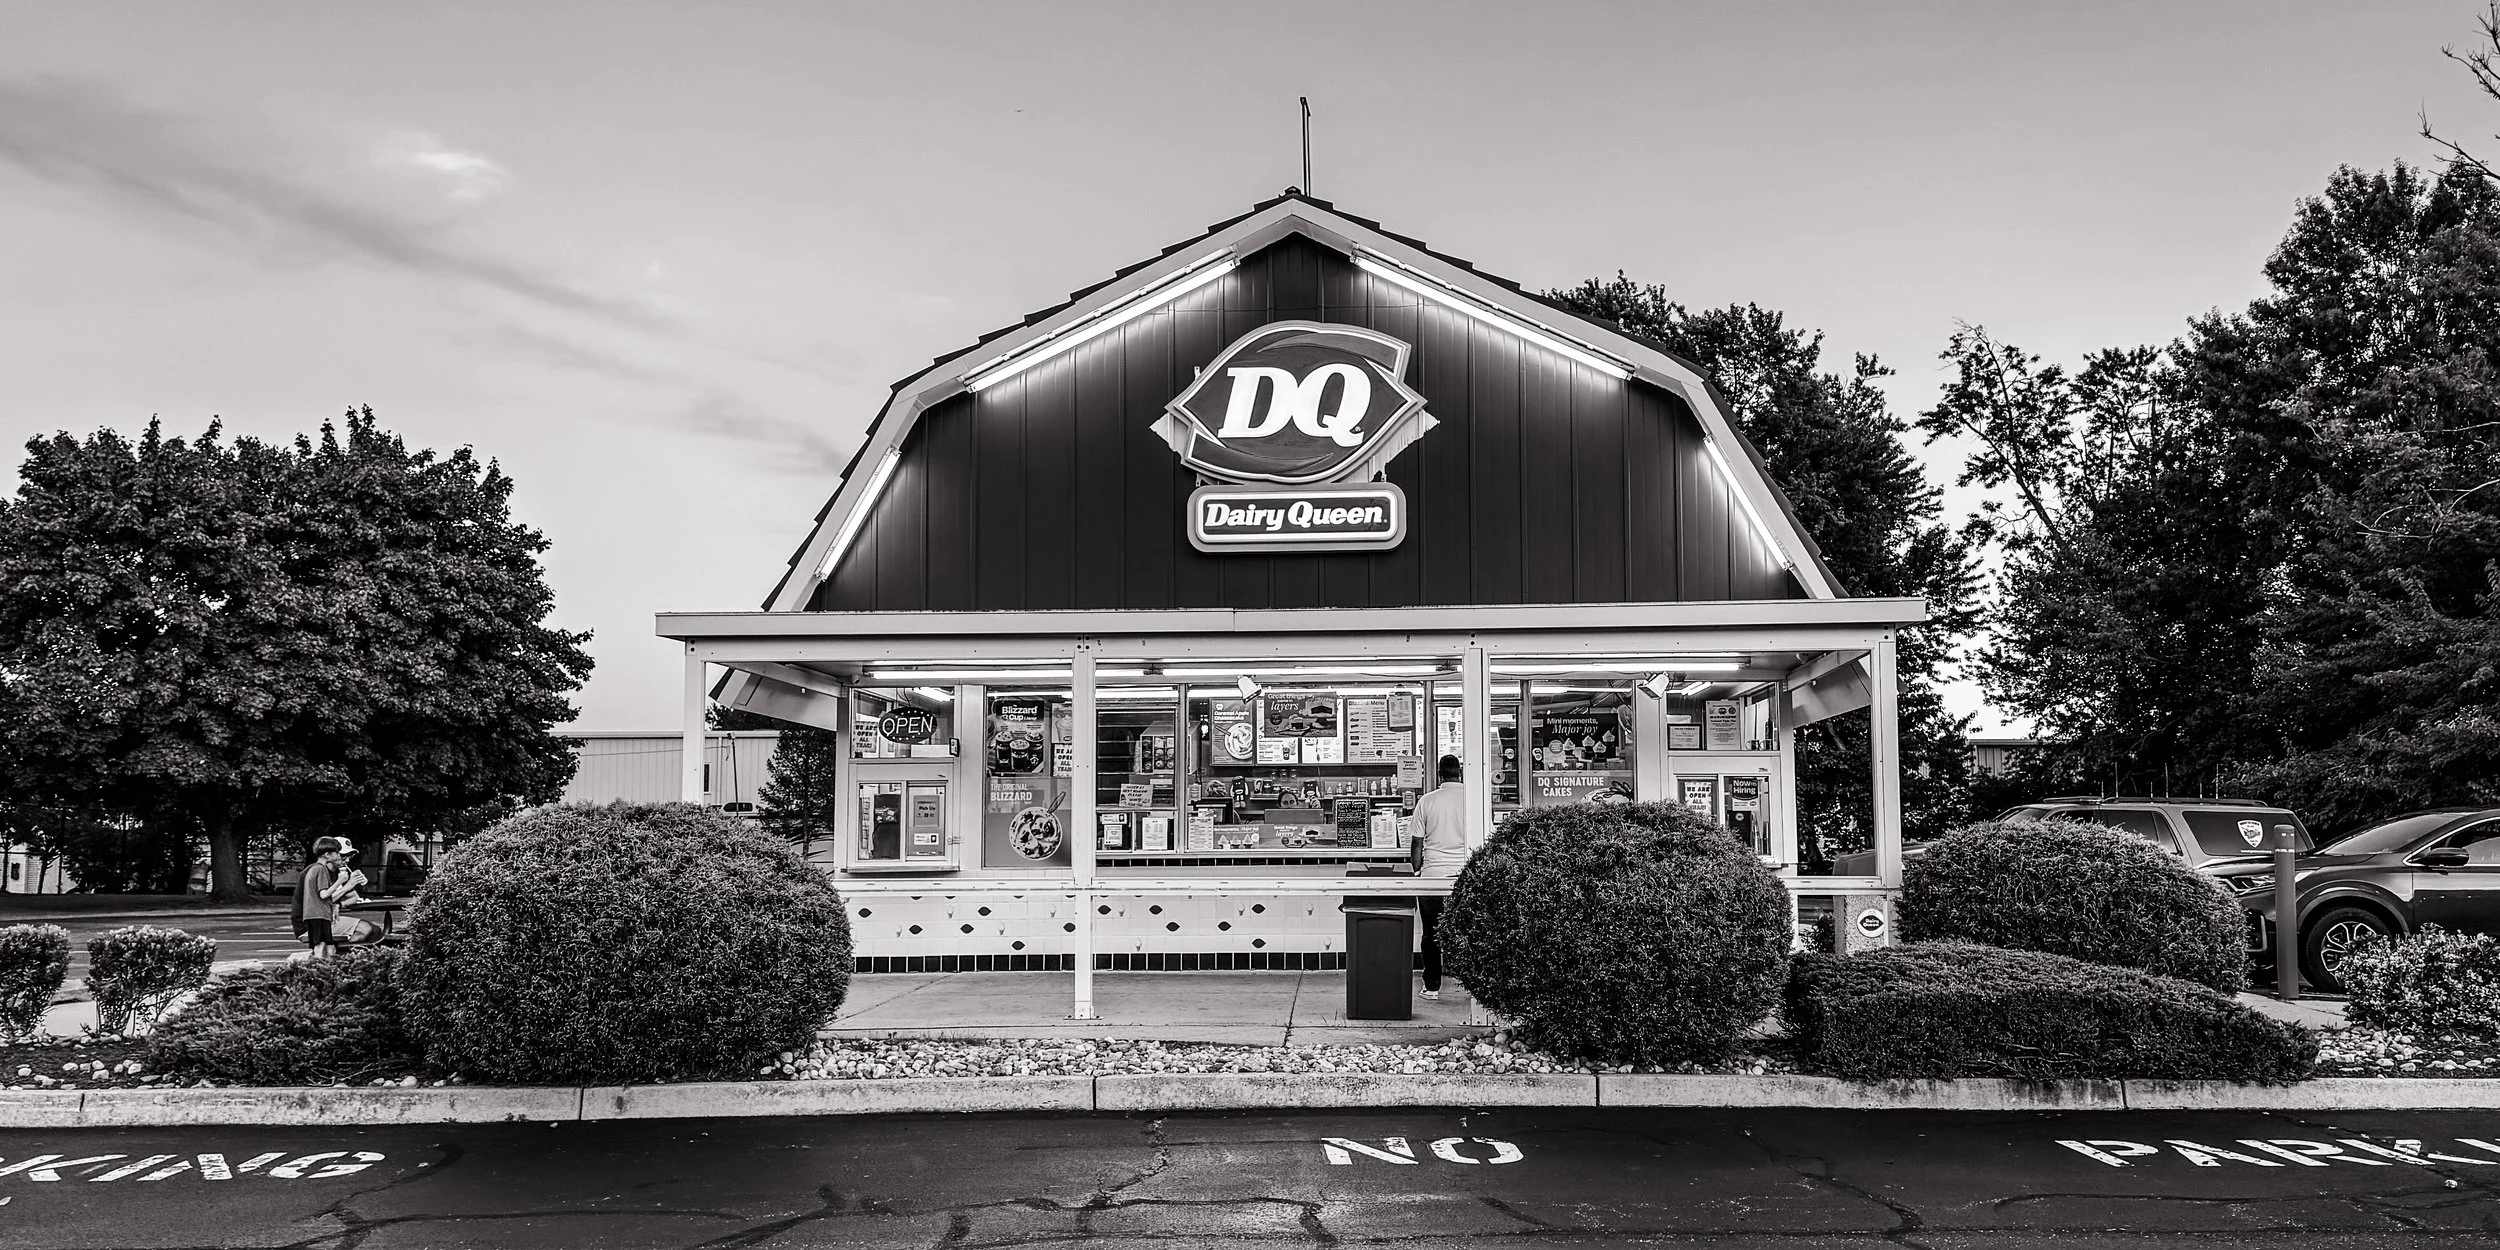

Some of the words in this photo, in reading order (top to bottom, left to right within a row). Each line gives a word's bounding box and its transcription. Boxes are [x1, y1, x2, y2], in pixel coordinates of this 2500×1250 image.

[1217, 363, 1372, 447] DQ
[1204, 502, 1286, 531] Dairy
[1285, 693, 1306, 701] things
[1001, 705, 1039, 714] Blizzard
[1270, 701, 1300, 713] layers
[882, 716, 934, 737] OPEN
[1546, 717, 1562, 725] Mini
[1562, 717, 1599, 726] moments,
[1552, 725, 1581, 736] Major
[1581, 725, 1599, 736] joy
[990, 783, 1002, 791] THE
[1002, 783, 1029, 791] ORIGINAL
[1537, 777, 1550, 787] DQ
[1553, 776, 1605, 786] SIGNATURE
[1732, 779, 1751, 787] Now
[1542, 787, 1573, 797] CAKES
[1733, 786, 1756, 795] Hiring
[990, 791, 1033, 802] BLIZZARD
[1321, 1136, 1525, 1165] NO
